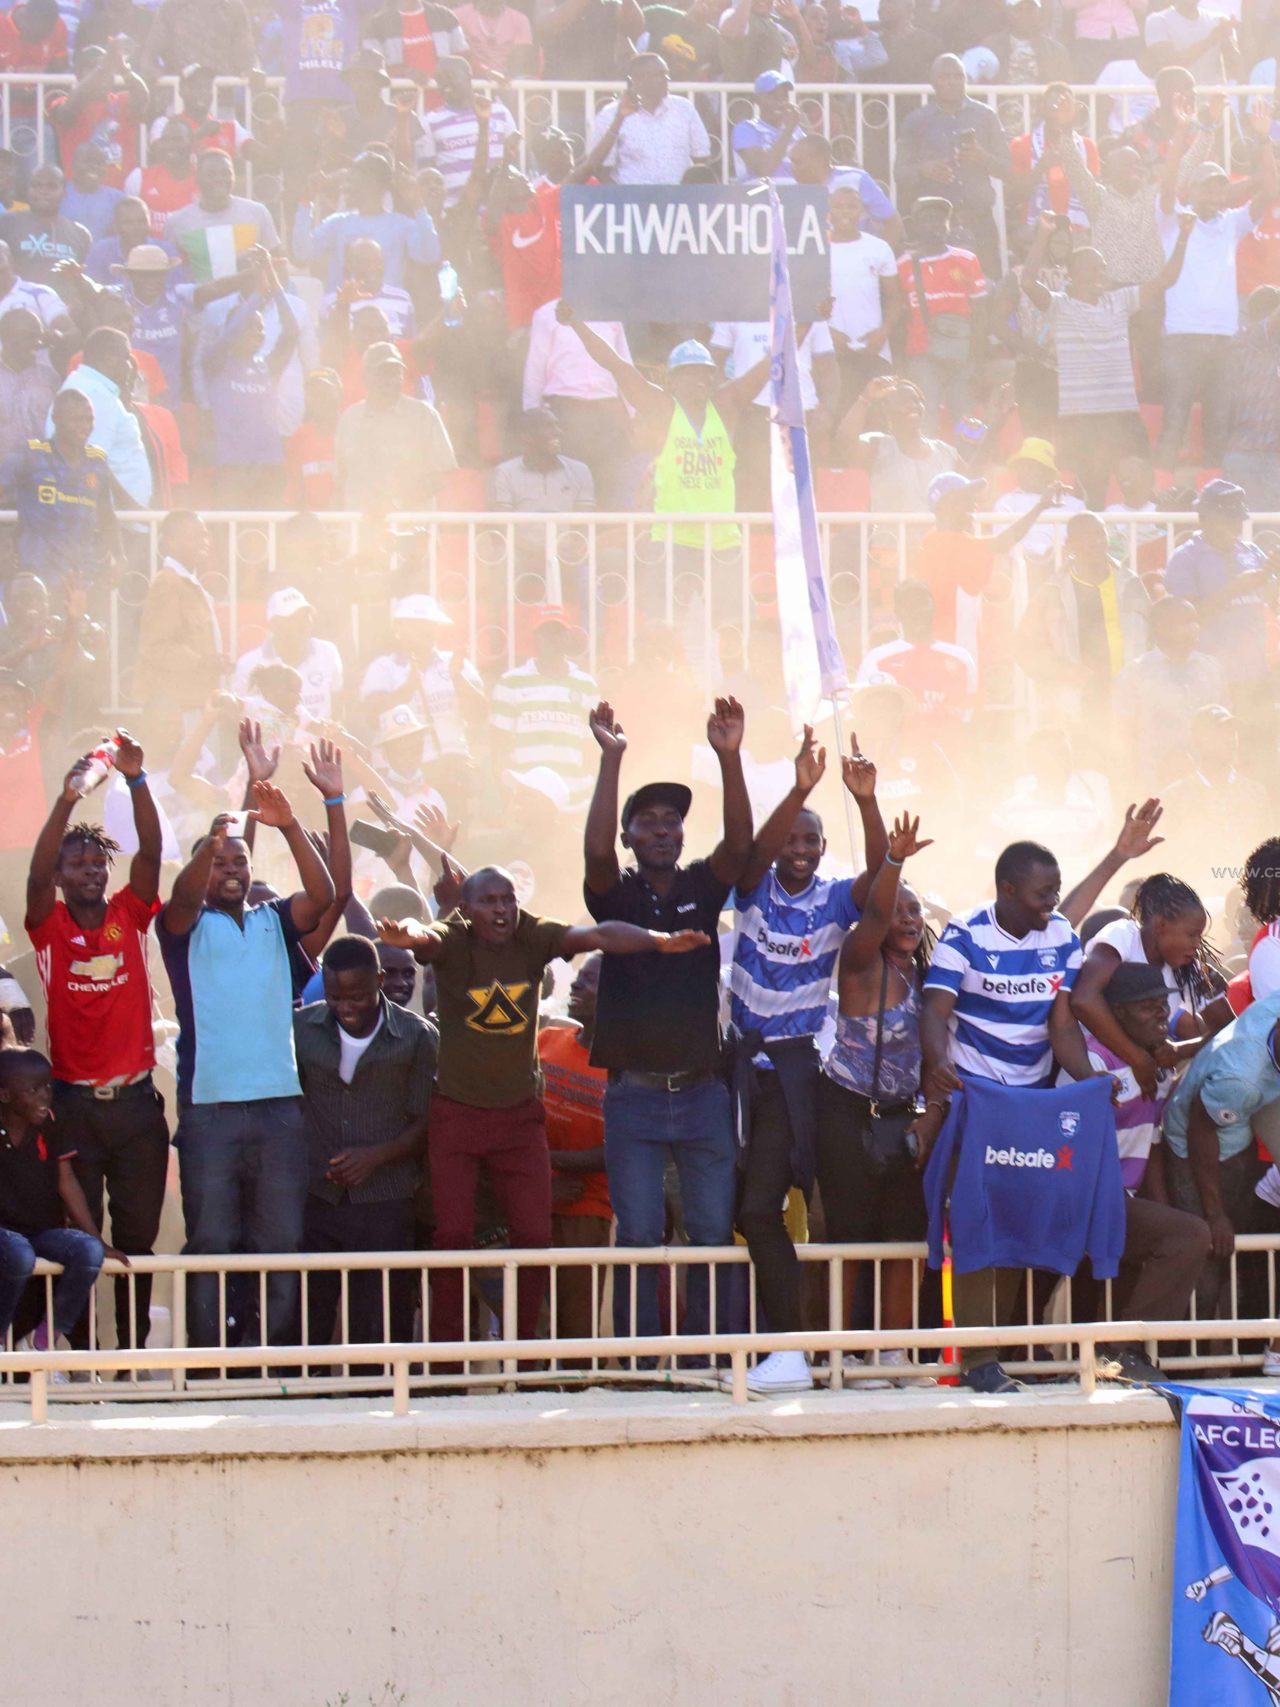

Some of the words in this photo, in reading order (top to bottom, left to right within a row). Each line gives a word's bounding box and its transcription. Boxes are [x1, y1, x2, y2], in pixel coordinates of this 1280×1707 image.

[757, 928, 800, 957] bsafe
[982, 975, 1046, 996] betsafe
[985, 1144, 1055, 1168] betsafe
[1193, 1423, 1240, 1448] AFC
